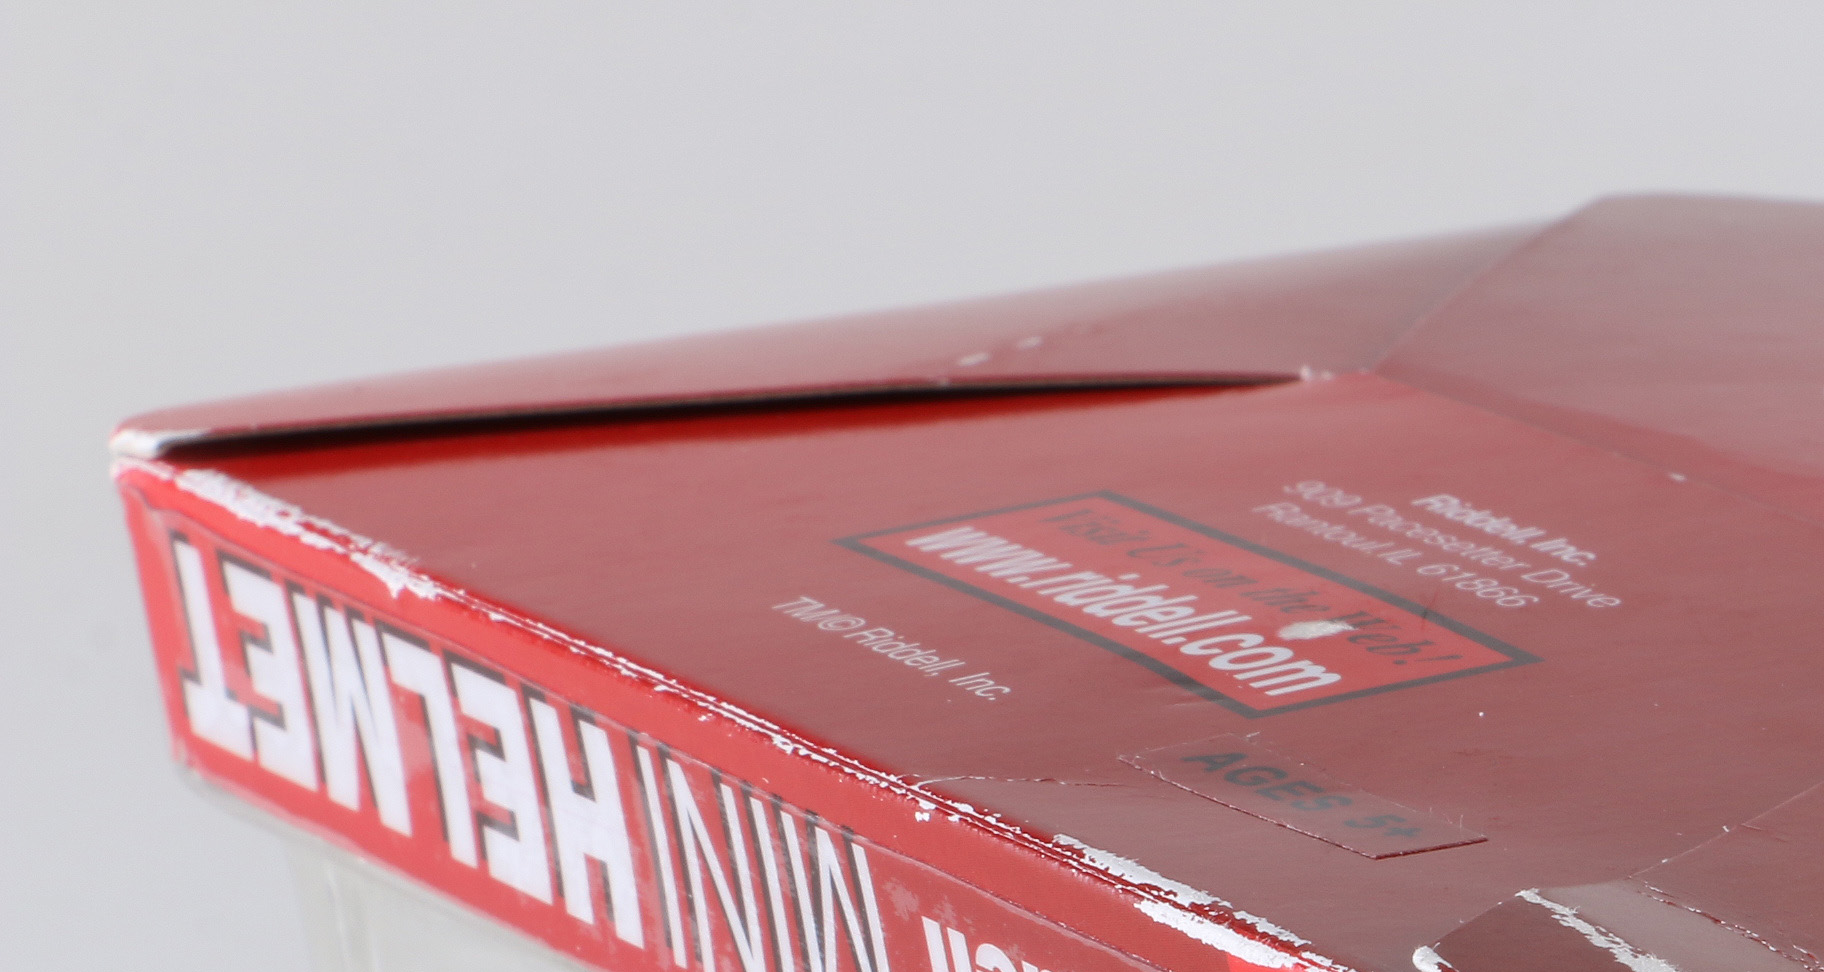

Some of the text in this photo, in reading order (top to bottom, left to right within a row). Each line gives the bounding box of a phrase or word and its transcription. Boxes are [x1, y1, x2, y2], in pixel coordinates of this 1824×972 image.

[1347, 503, 1532, 571] Pacesetter
[1521, 568, 1621, 608] Drive
[1416, 563, 1540, 608] 61866
[1531, 537, 1597, 567] Inc.
[905, 525, 1343, 697] www.riddell.com
[1181, 567, 1260, 589] on
[1239, 587, 1331, 615] the
[949, 672, 1011, 701] Inc.
[172, 531, 645, 949] HELMET
[1180, 751, 1423, 838] AGES 5+
